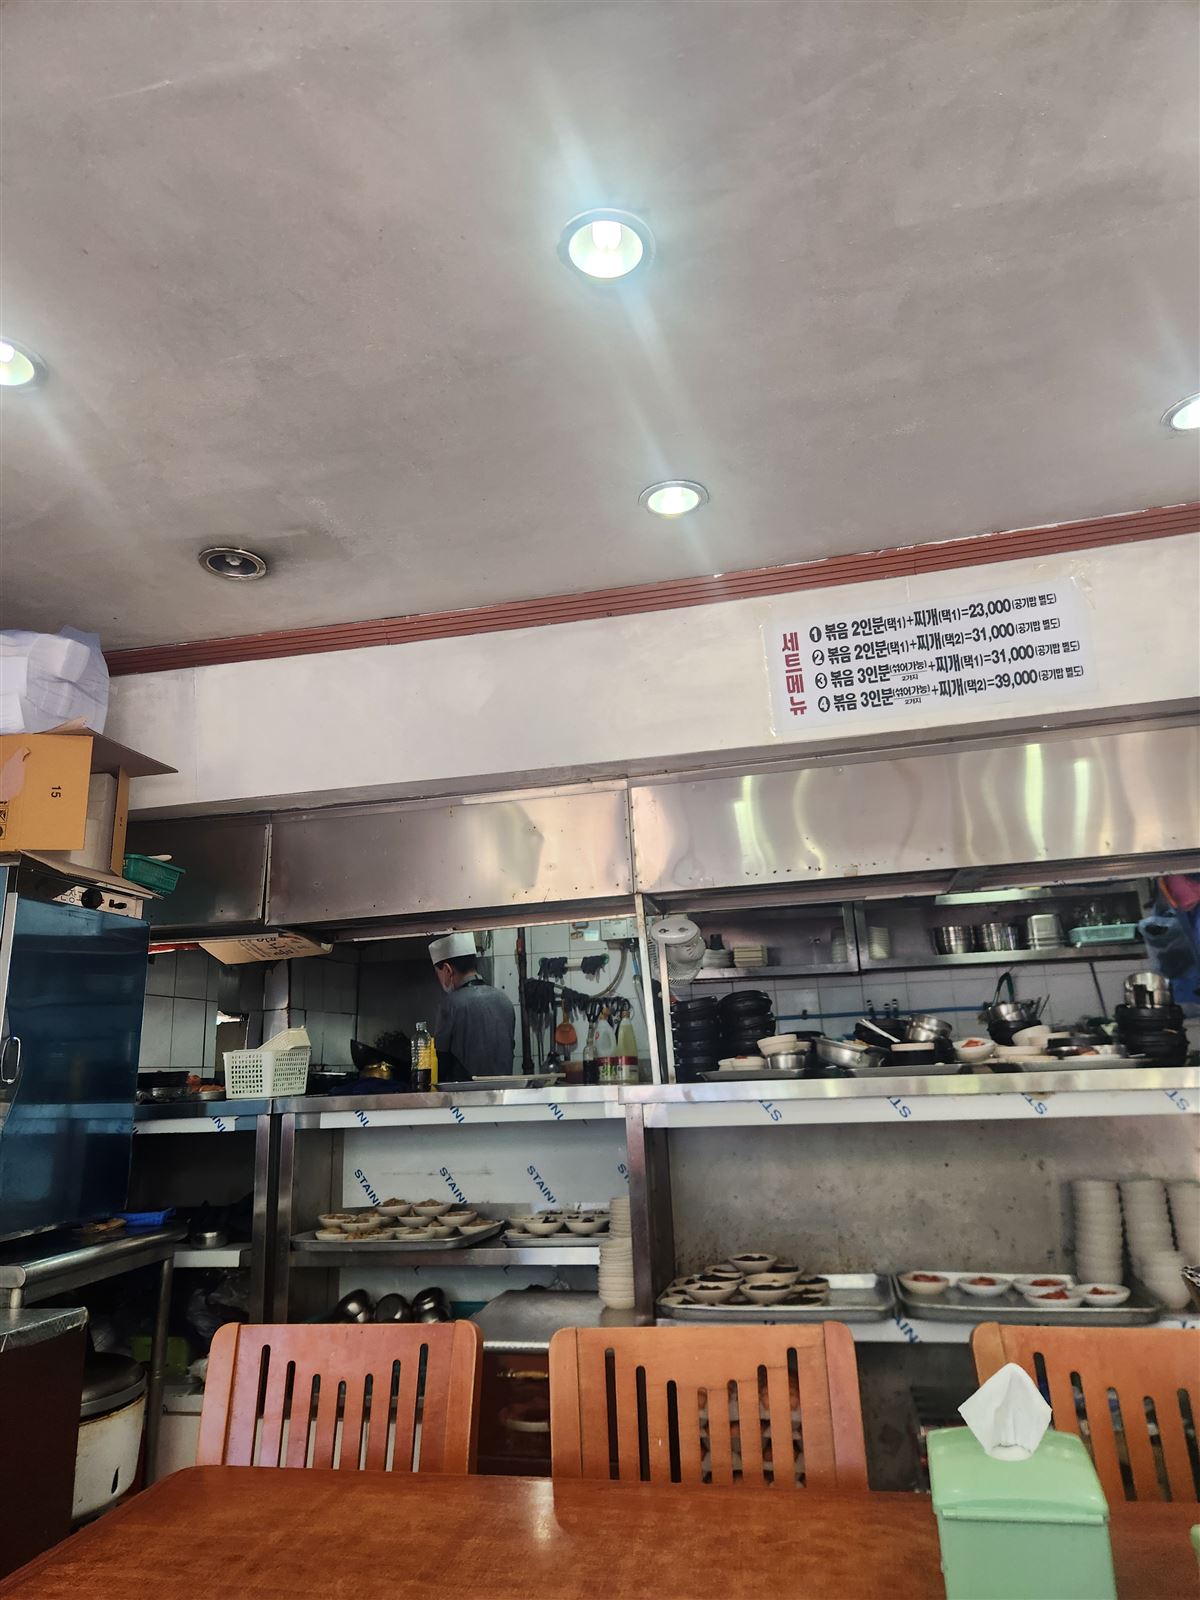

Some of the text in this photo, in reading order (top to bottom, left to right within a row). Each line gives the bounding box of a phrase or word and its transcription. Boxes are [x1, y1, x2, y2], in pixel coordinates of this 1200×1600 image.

[824, 622, 849, 641] 볶음
[827, 645, 851, 665] 볶음
[782, 632, 807, 716] 세트메뉴
[830, 668, 854, 688] 볶음
[833, 692, 857, 712] 볶음
[50, 785, 61, 798] 15
